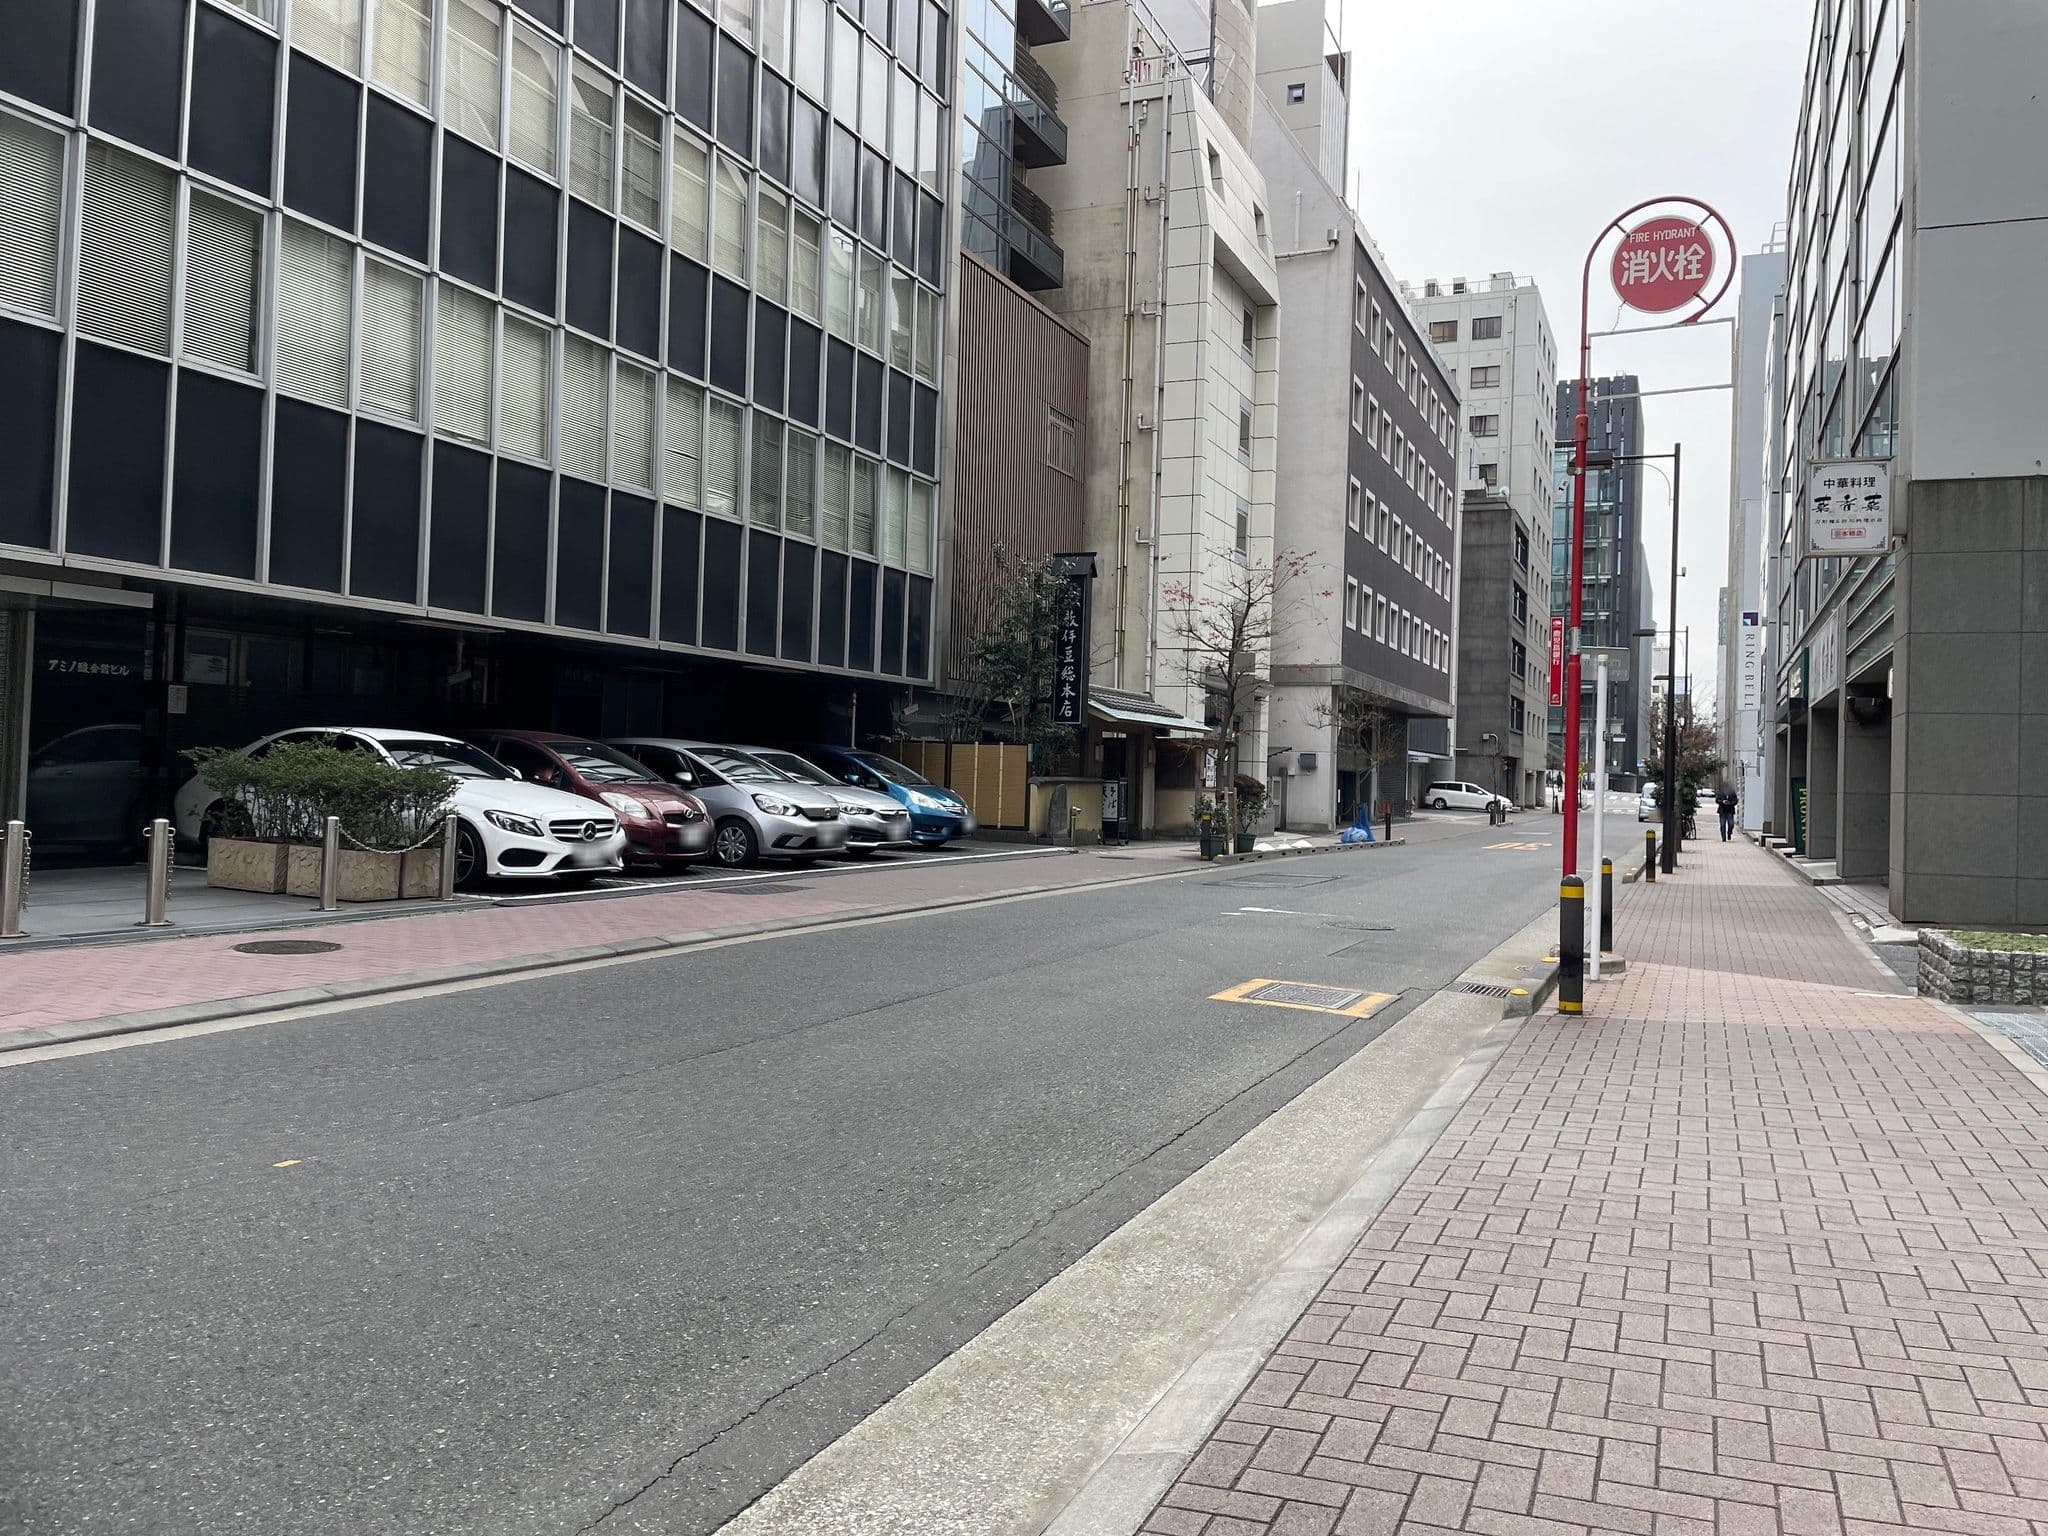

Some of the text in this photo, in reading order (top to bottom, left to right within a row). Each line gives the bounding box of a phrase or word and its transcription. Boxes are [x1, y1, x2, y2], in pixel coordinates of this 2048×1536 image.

[1629, 227, 1696, 243] FIRE HYDRANT
[1621, 243, 1706, 286] 消火栓
[1823, 476, 1876, 489] 中華料理
[1744, 633, 1755, 709] RINGBELL
